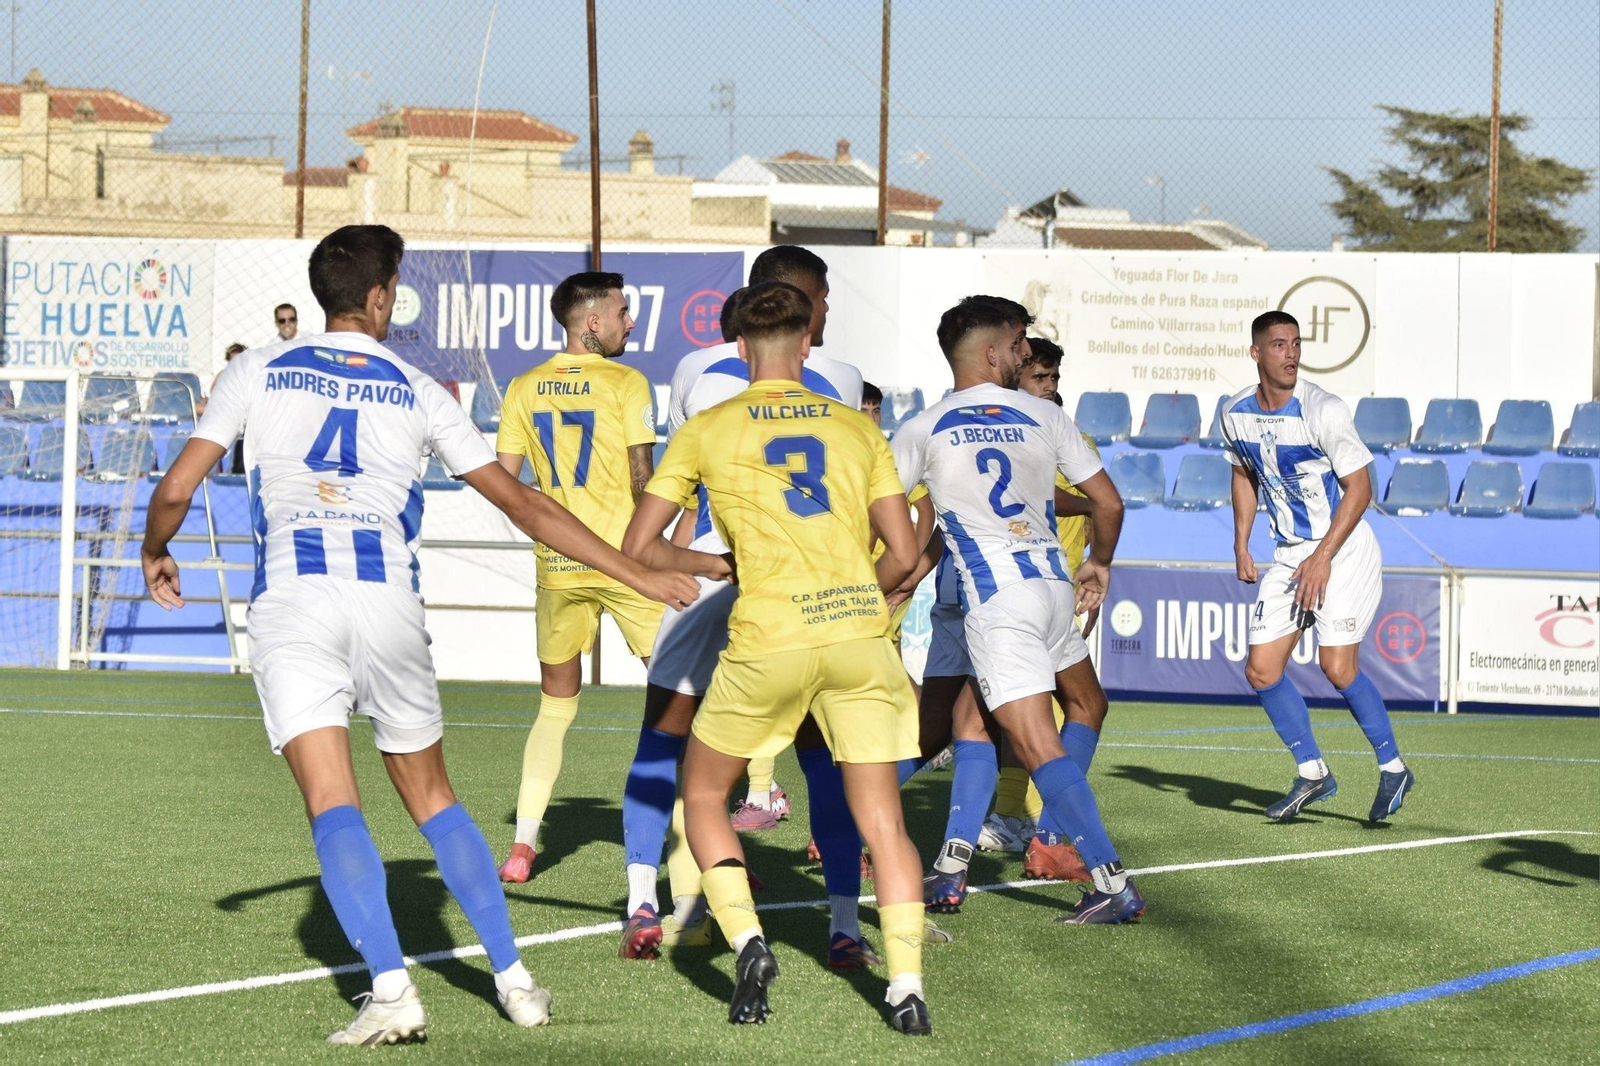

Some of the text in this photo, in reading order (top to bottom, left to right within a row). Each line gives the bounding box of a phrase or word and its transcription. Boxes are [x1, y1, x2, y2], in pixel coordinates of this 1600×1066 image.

[1112, 267, 1239, 284] Yeguada Flor De Jara
[1081, 291, 1269, 311] Criadores de Pura Raza español
[41, 303, 188, 338] HUELVA
[1110, 316, 1244, 333] Camino Villarrasa km1
[110, 341, 190, 353] DE DESARROLLO
[1088, 340, 1251, 358] Bollullos del Condado/Huelv
[110, 353, 189, 368] SOSTENIBLE
[1132, 365, 1216, 381] Tlf 626379916
[265, 371, 415, 411] ANDRES PAVÓN
[537, 381, 591, 396] UTRILLA
[747, 403, 832, 420] VILCHEZ
[303, 406, 364, 477] 4
[950, 427, 1026, 446] J.BECKEN
[532, 409, 596, 489] 17
[762, 434, 832, 520] 3
[975, 447, 1026, 518] 2
[791, 594, 813, 603] C.D.
[801, 595, 879, 614] HUÉTOR TÁJAR
[1111, 639, 1141, 650] TERCERA
[1549, 659, 1561, 671] en
[1563, 657, 1599, 676] general
